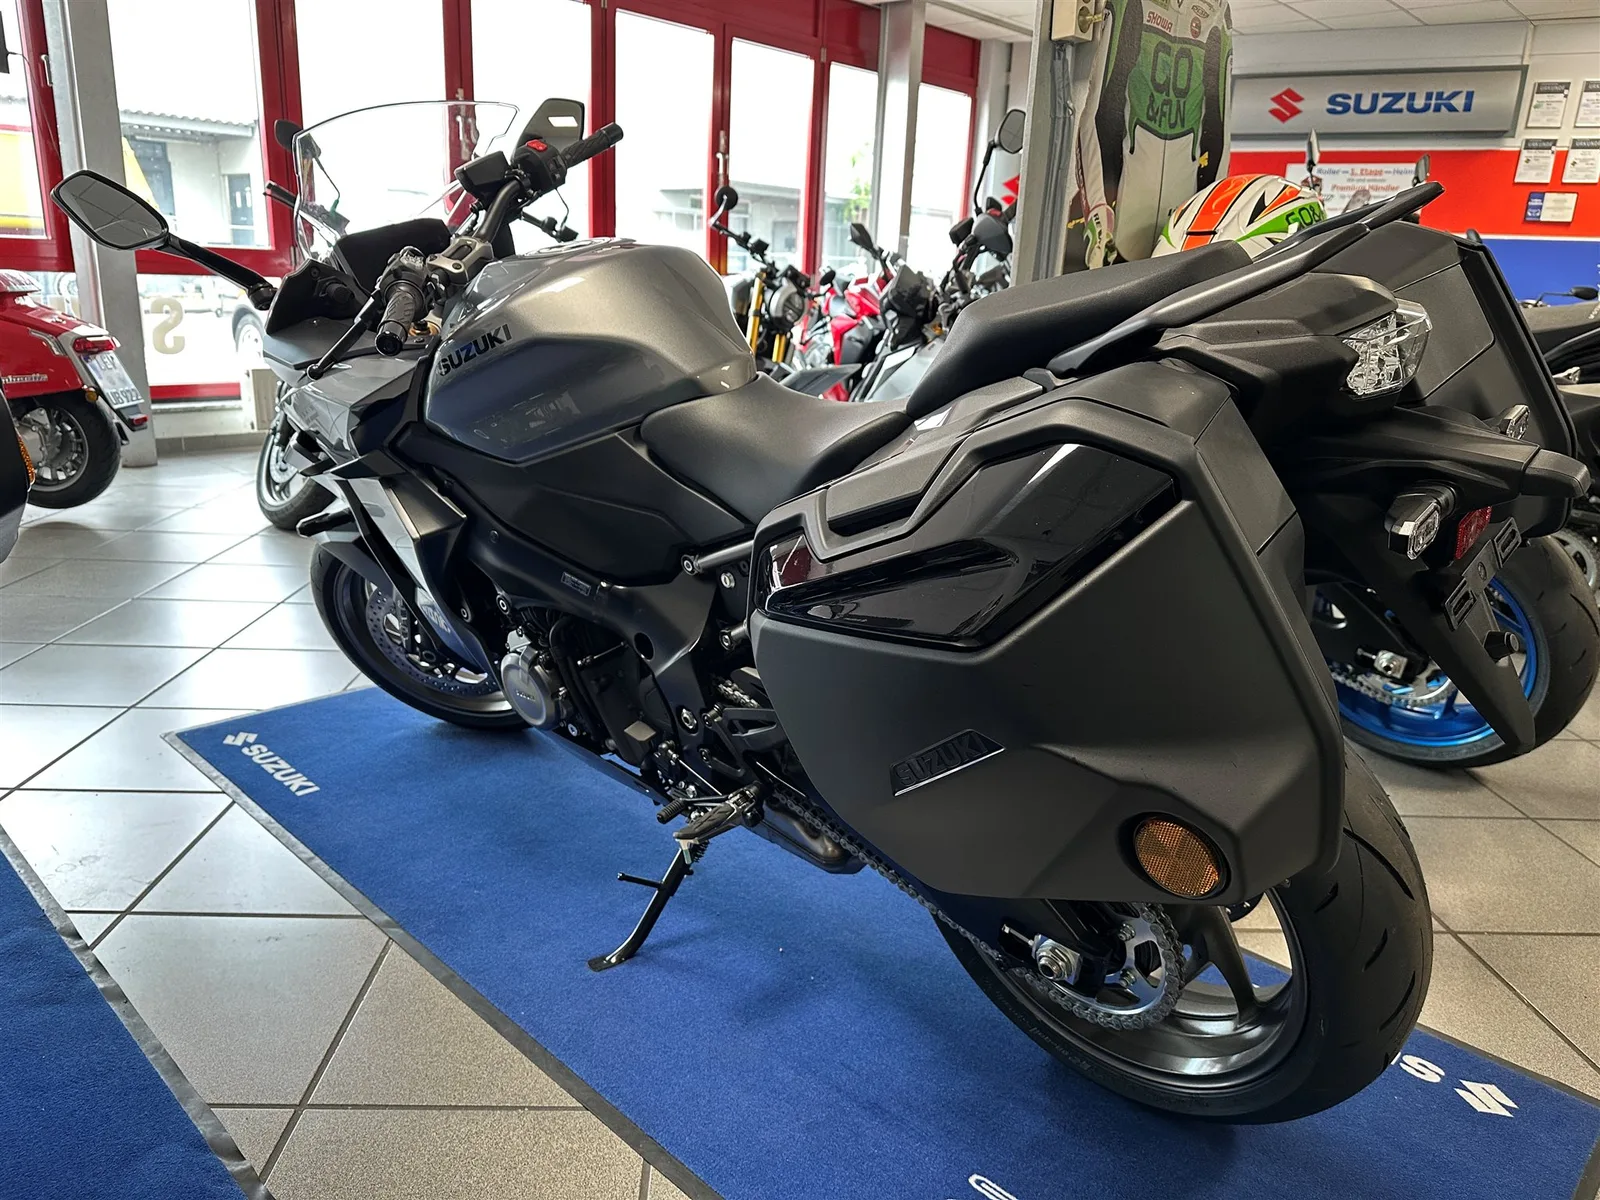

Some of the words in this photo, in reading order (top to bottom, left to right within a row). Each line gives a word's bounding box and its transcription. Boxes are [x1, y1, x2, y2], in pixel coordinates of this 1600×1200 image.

[1146, 11, 1173, 32] SHOWA
[1151, 41, 1193, 98] GO
[1146, 92, 1187, 129] &FUN
[1326, 90, 1475, 115] SUZUKI
[439, 324, 512, 376] SUZUKI
[241, 744, 320, 797] SUZUKI
[895, 733, 988, 786] SUZUKI
